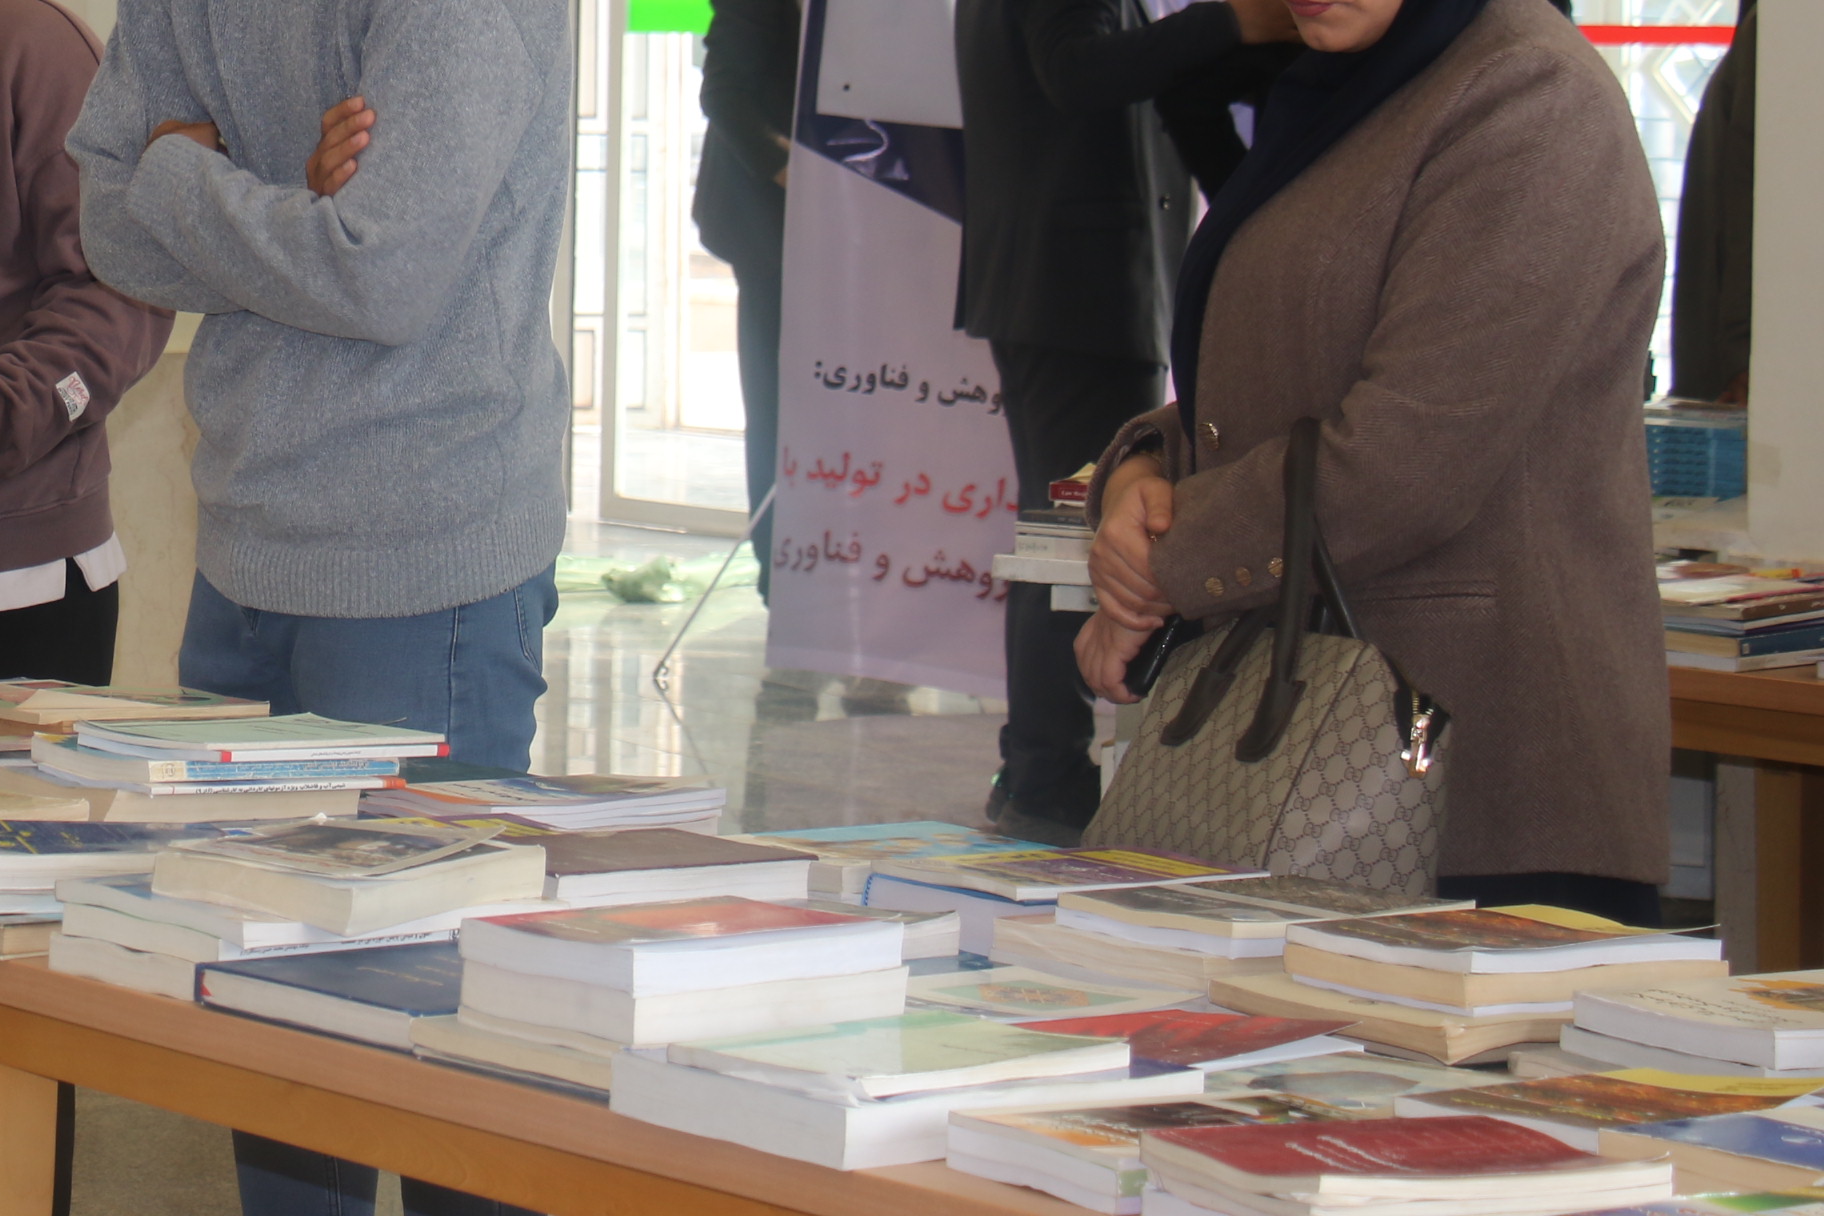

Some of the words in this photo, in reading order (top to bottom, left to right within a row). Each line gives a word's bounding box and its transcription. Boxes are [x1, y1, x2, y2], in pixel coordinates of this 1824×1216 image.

[813, 360, 909, 395] فناوری:
[914, 381, 930, 402] و
[937, 377, 1004, 415] وهش
[806, 452, 883, 498] تولید
[893, 472, 932, 505] در
[942, 477, 1019, 519] اری
[775, 530, 862, 573] فناوری
[871, 553, 890, 580] و
